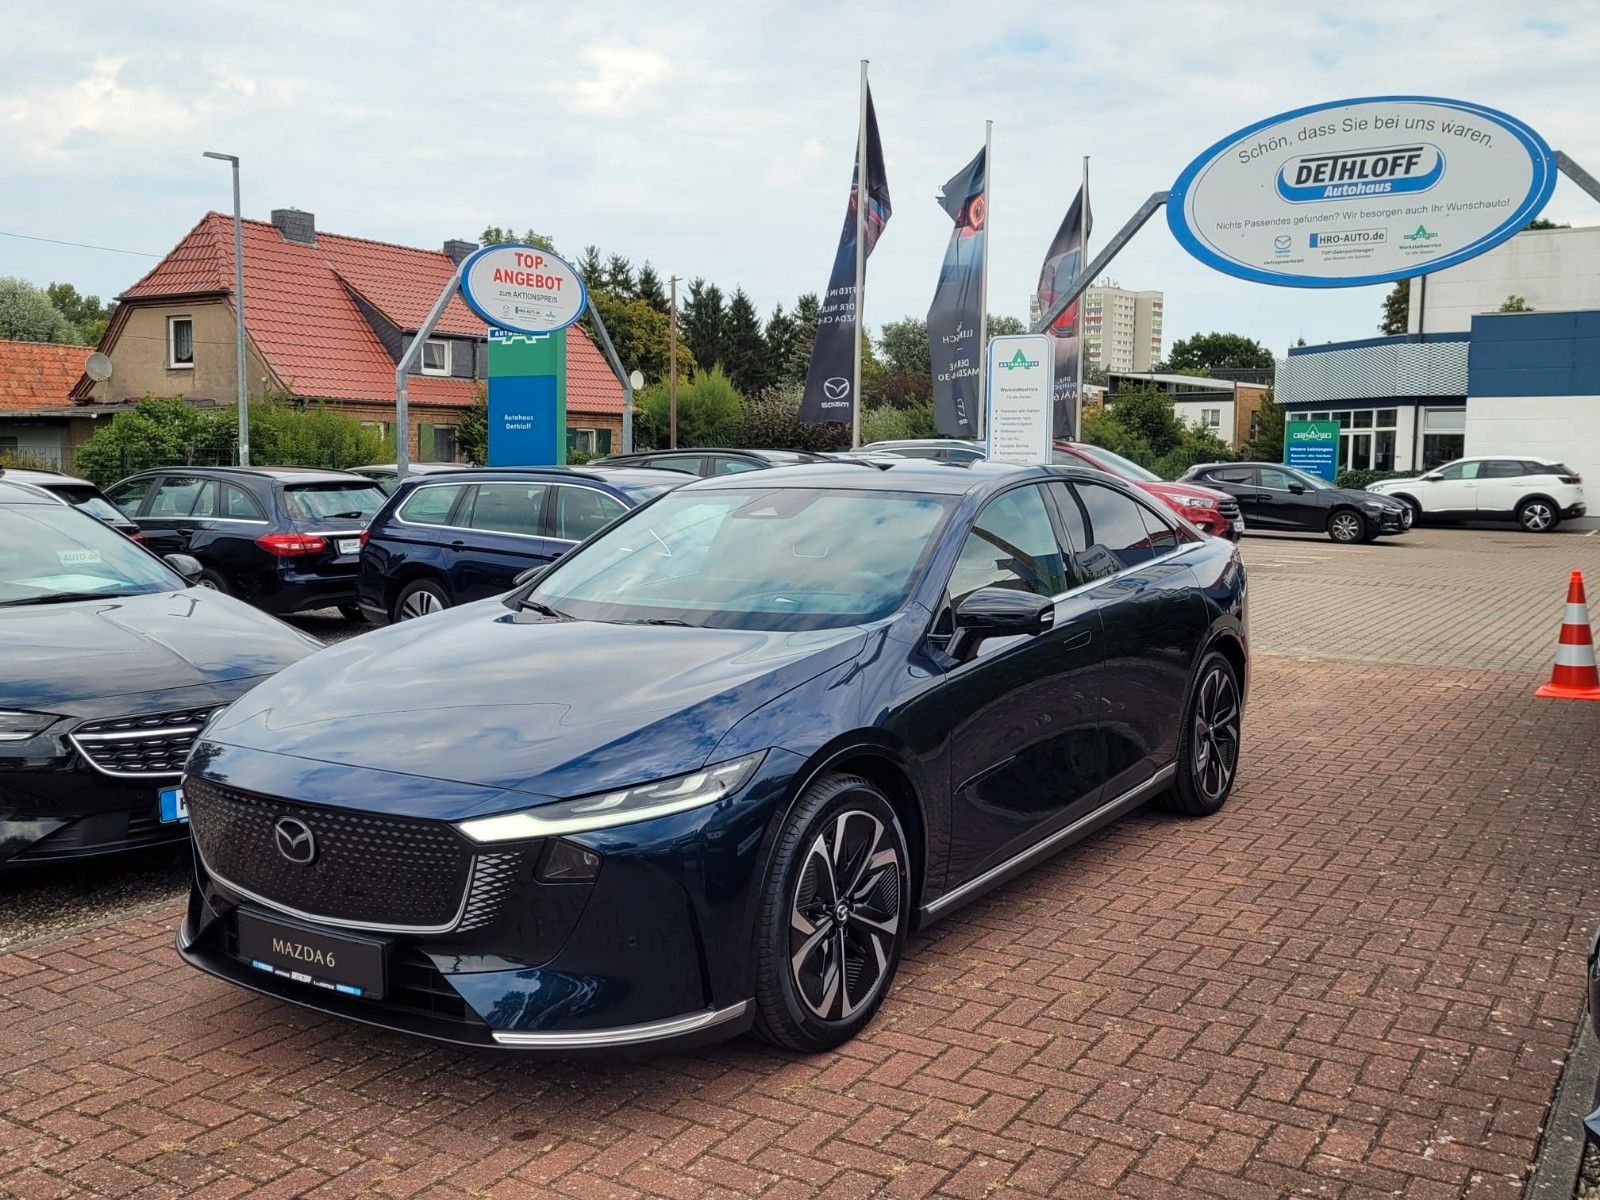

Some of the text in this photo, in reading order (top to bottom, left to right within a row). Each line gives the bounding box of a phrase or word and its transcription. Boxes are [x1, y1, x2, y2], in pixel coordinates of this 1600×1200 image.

[1239, 115, 1493, 164] Schön, dass Sie bei uns waren.
[1295, 147, 1423, 186] DETHLOFF
[1324, 182, 1391, 198] Autohaus
[1216, 198, 1510, 230] Nichts Passendes gefunden? Wir besorgen auch Ihr Wunschauto!
[1319, 231, 1384, 244] HRO-AUTO.de
[515, 252, 548, 269] TOP-
[493, 268, 563, 291] ANGEBOT
[513, 291, 558, 303] AKTIONSPREIS
